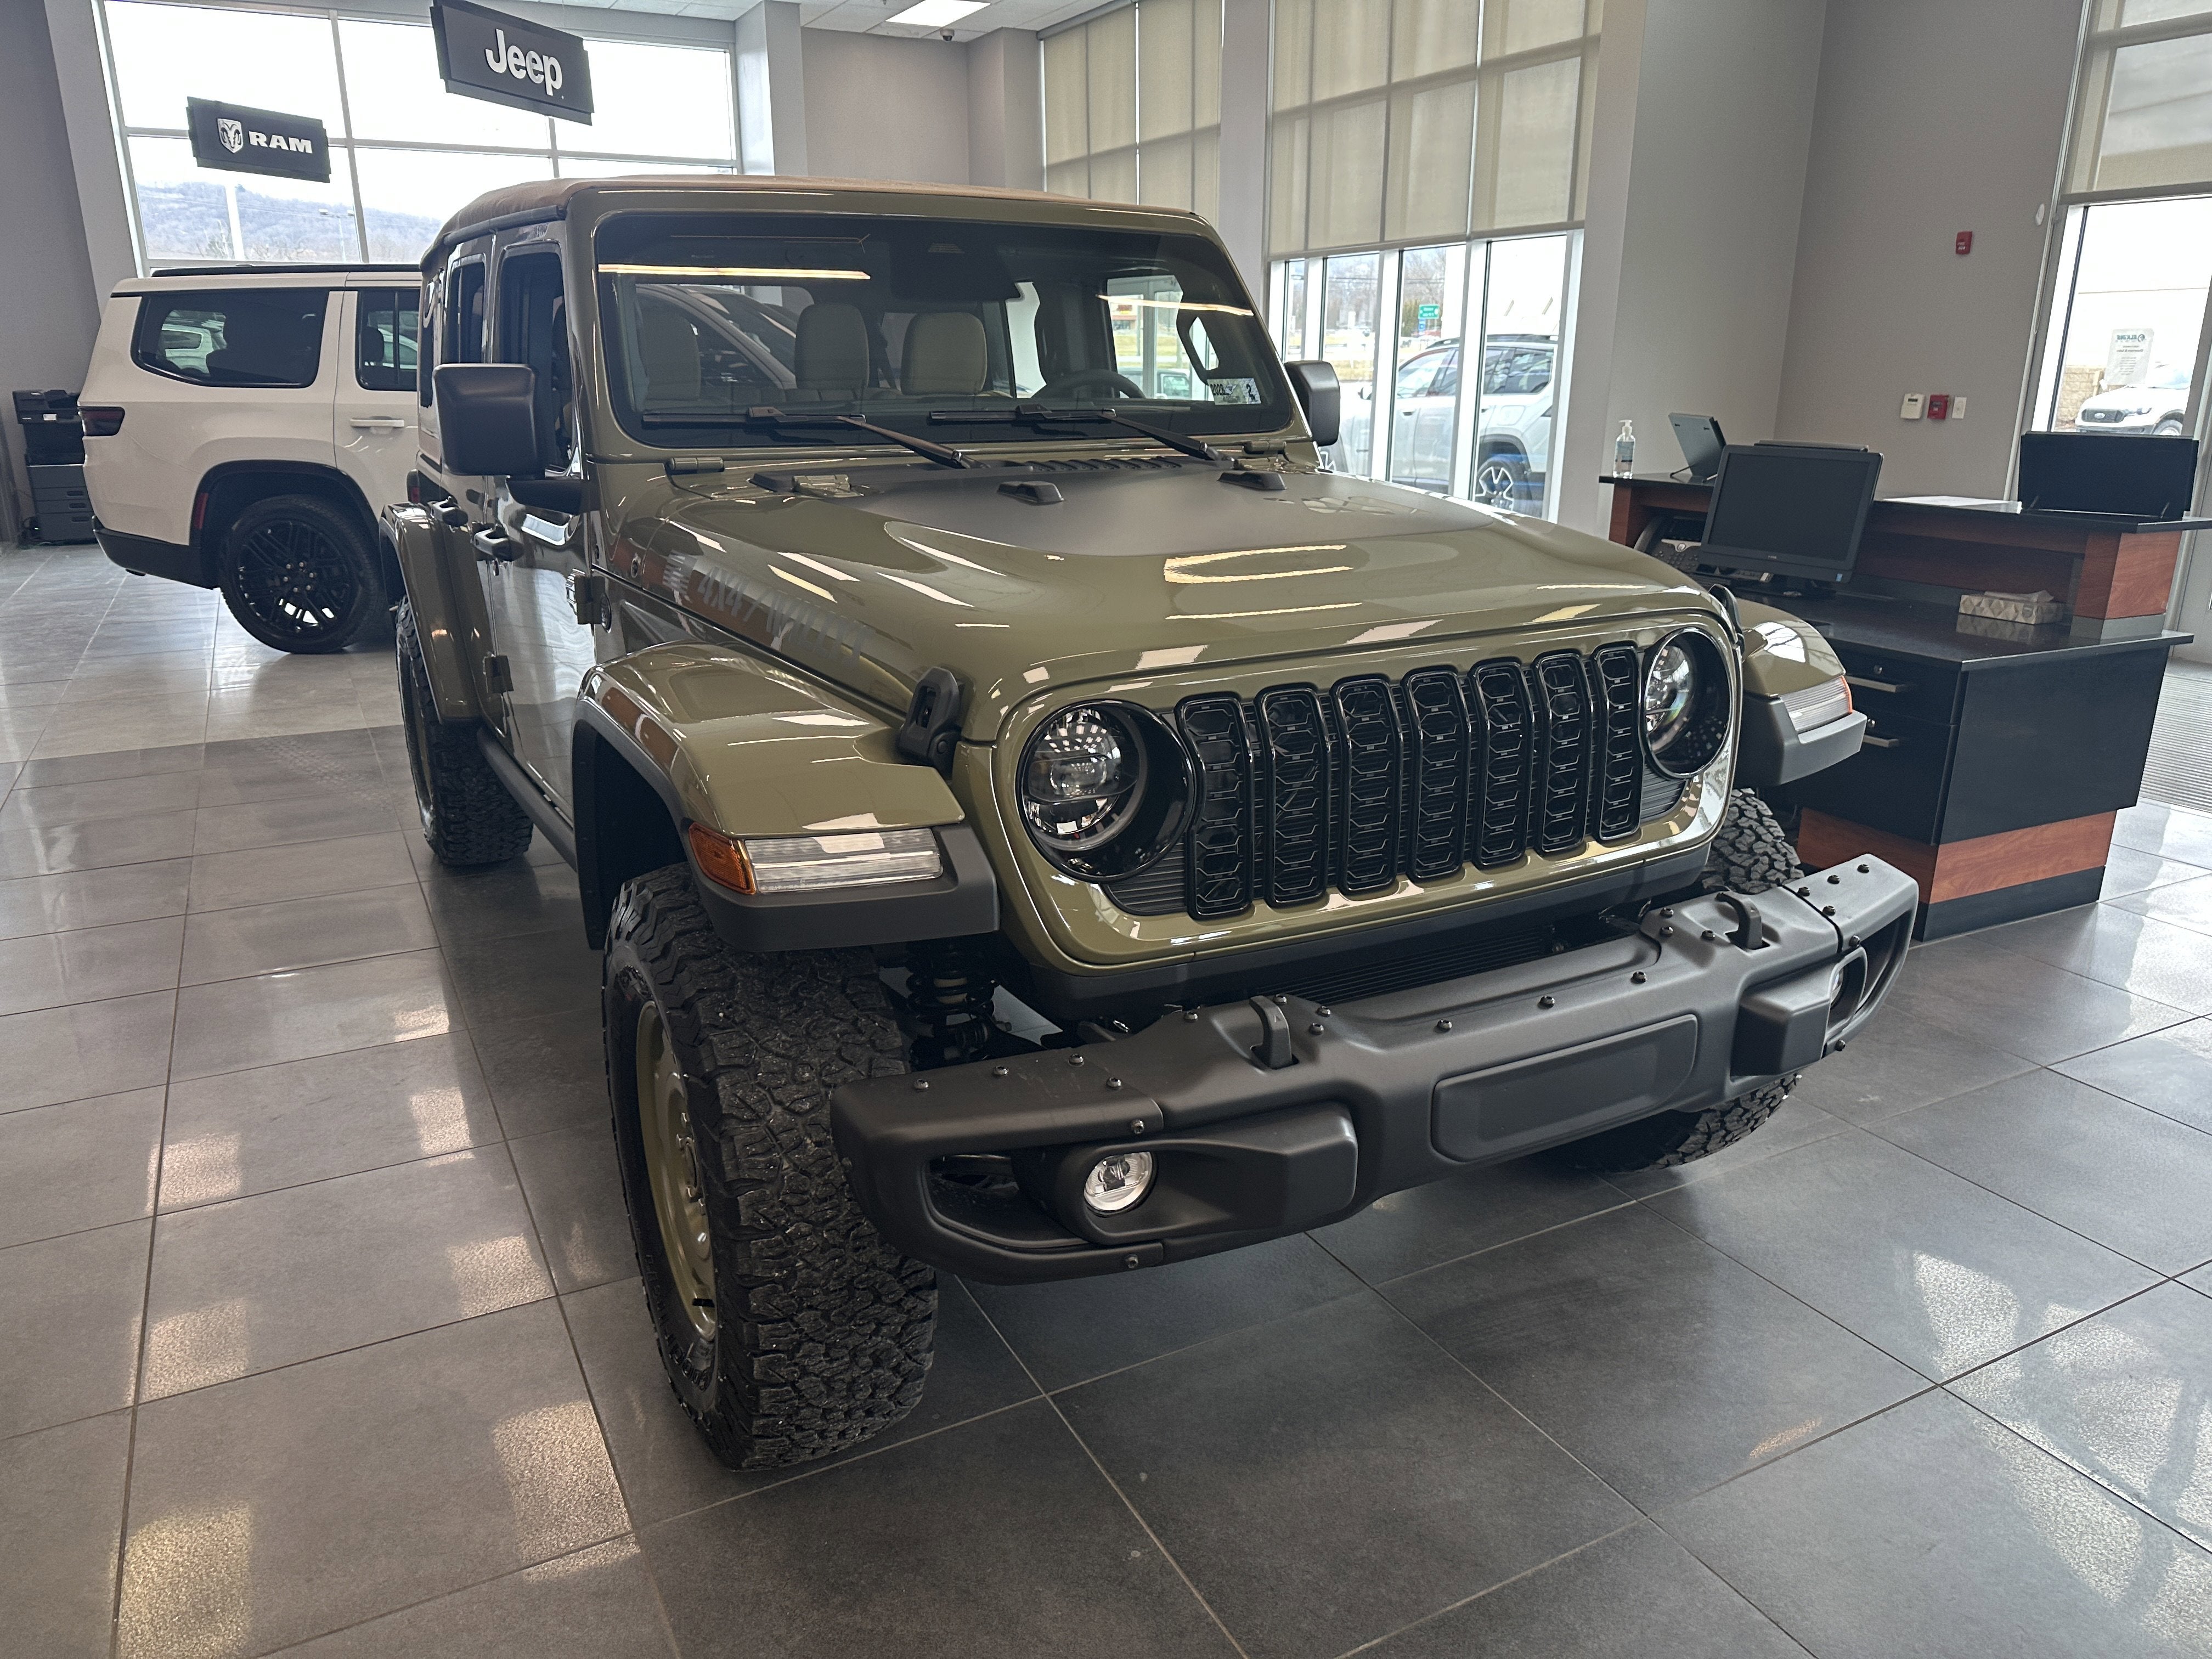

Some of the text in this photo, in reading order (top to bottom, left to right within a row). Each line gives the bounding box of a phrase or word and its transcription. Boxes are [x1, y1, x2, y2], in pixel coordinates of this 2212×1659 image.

[486, 29, 563, 96] Jeep
[249, 131, 313, 154] RAM
[697, 566, 750, 618] 4X4
